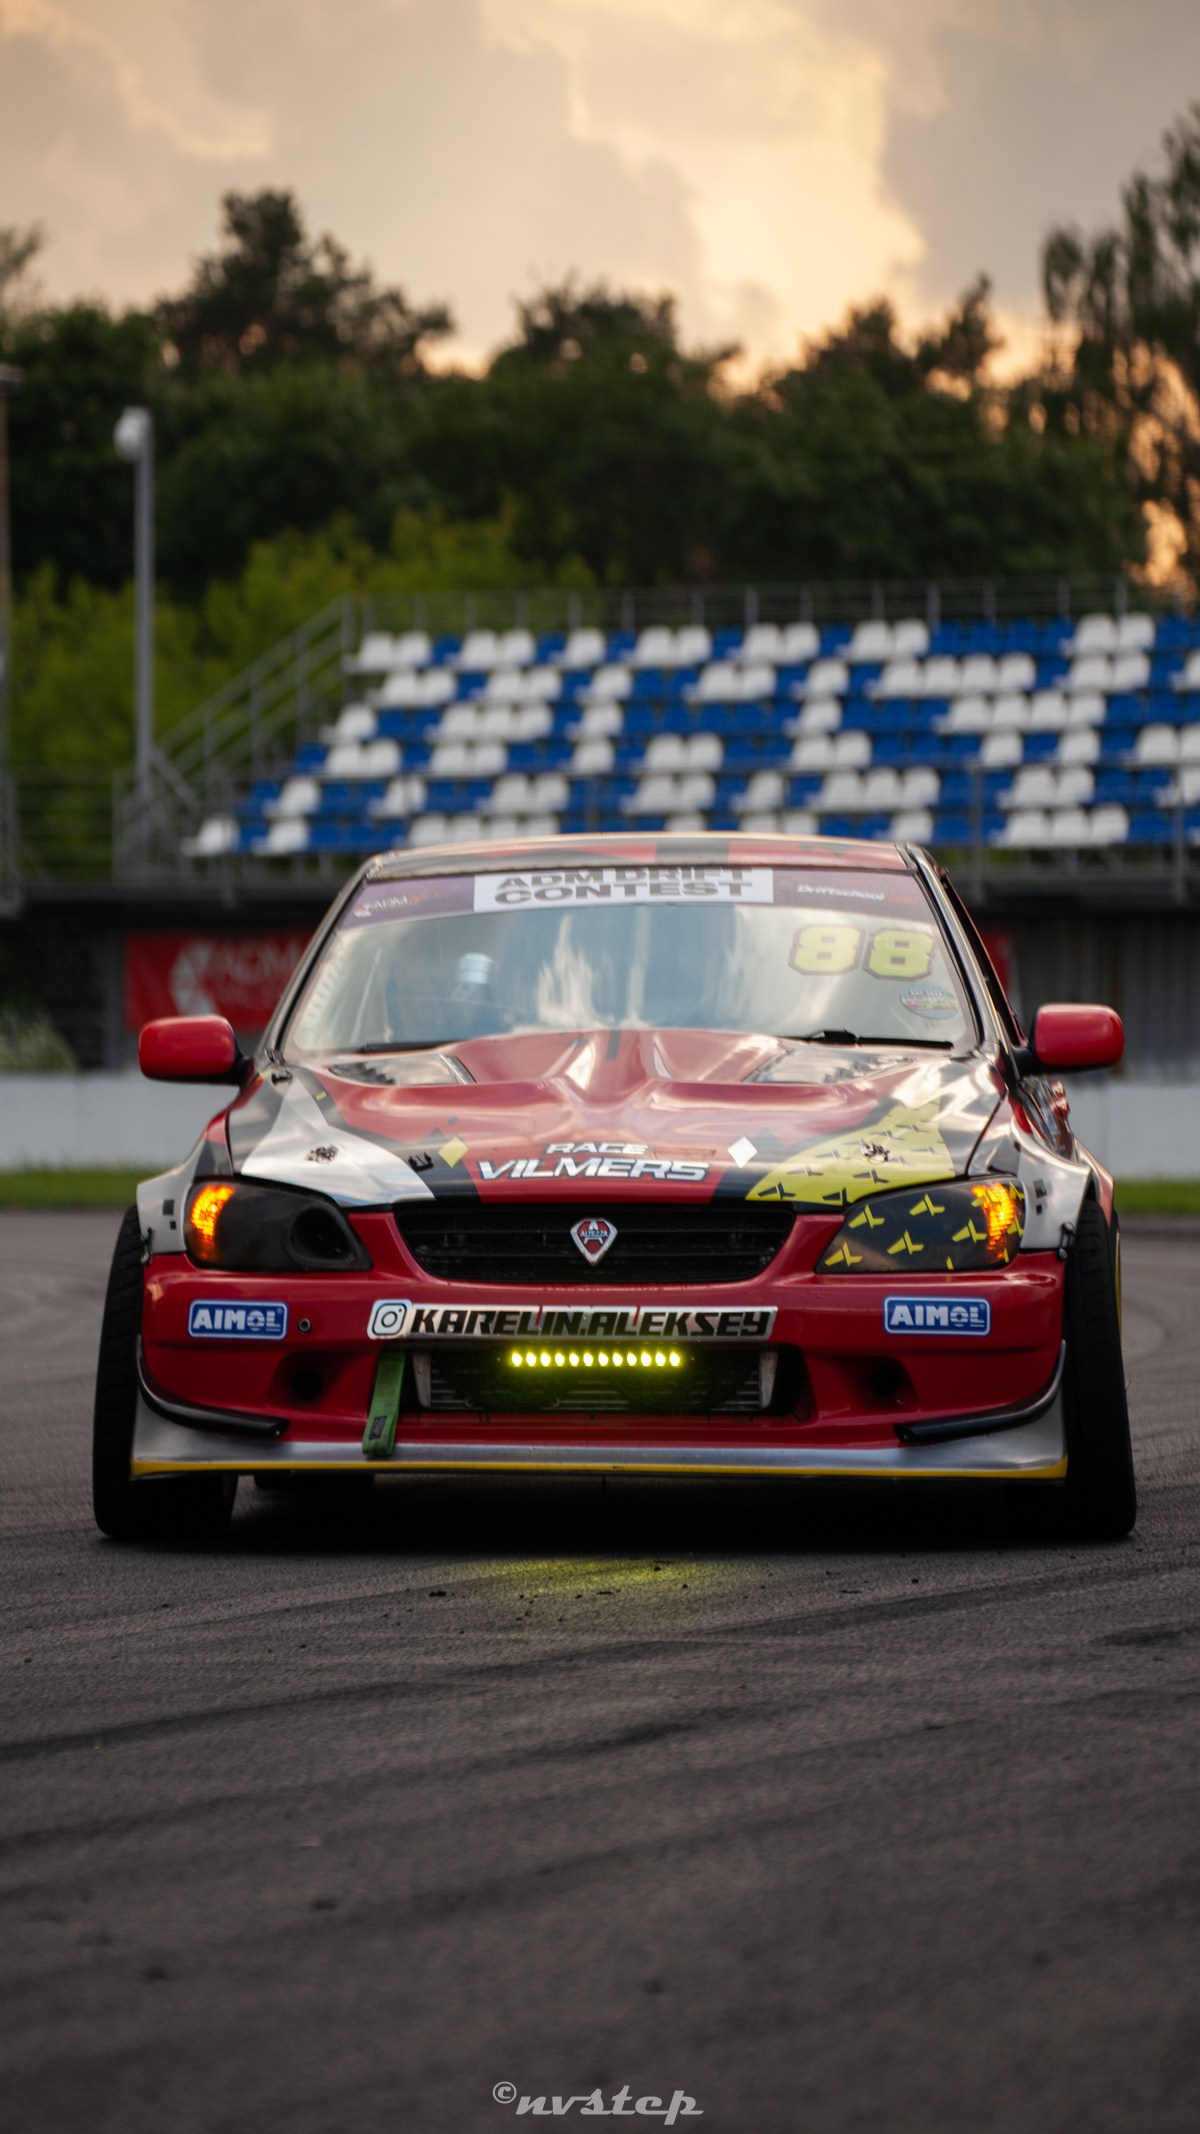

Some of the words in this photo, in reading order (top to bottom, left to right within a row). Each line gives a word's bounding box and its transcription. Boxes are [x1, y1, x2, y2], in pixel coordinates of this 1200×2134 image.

[497, 869, 604, 890] ADM
[614, 867, 752, 881] DRIFT
[495, 882, 753, 906] CONTEST
[788, 924, 934, 981] 88
[546, 1142, 649, 1155] RACE
[478, 1157, 711, 1181] VILMERS
[192, 1308, 281, 1332] AIMOL
[411, 1308, 770, 1337] KARELIN.ALEKSEY
[889, 1304, 985, 1328] AIMOL
